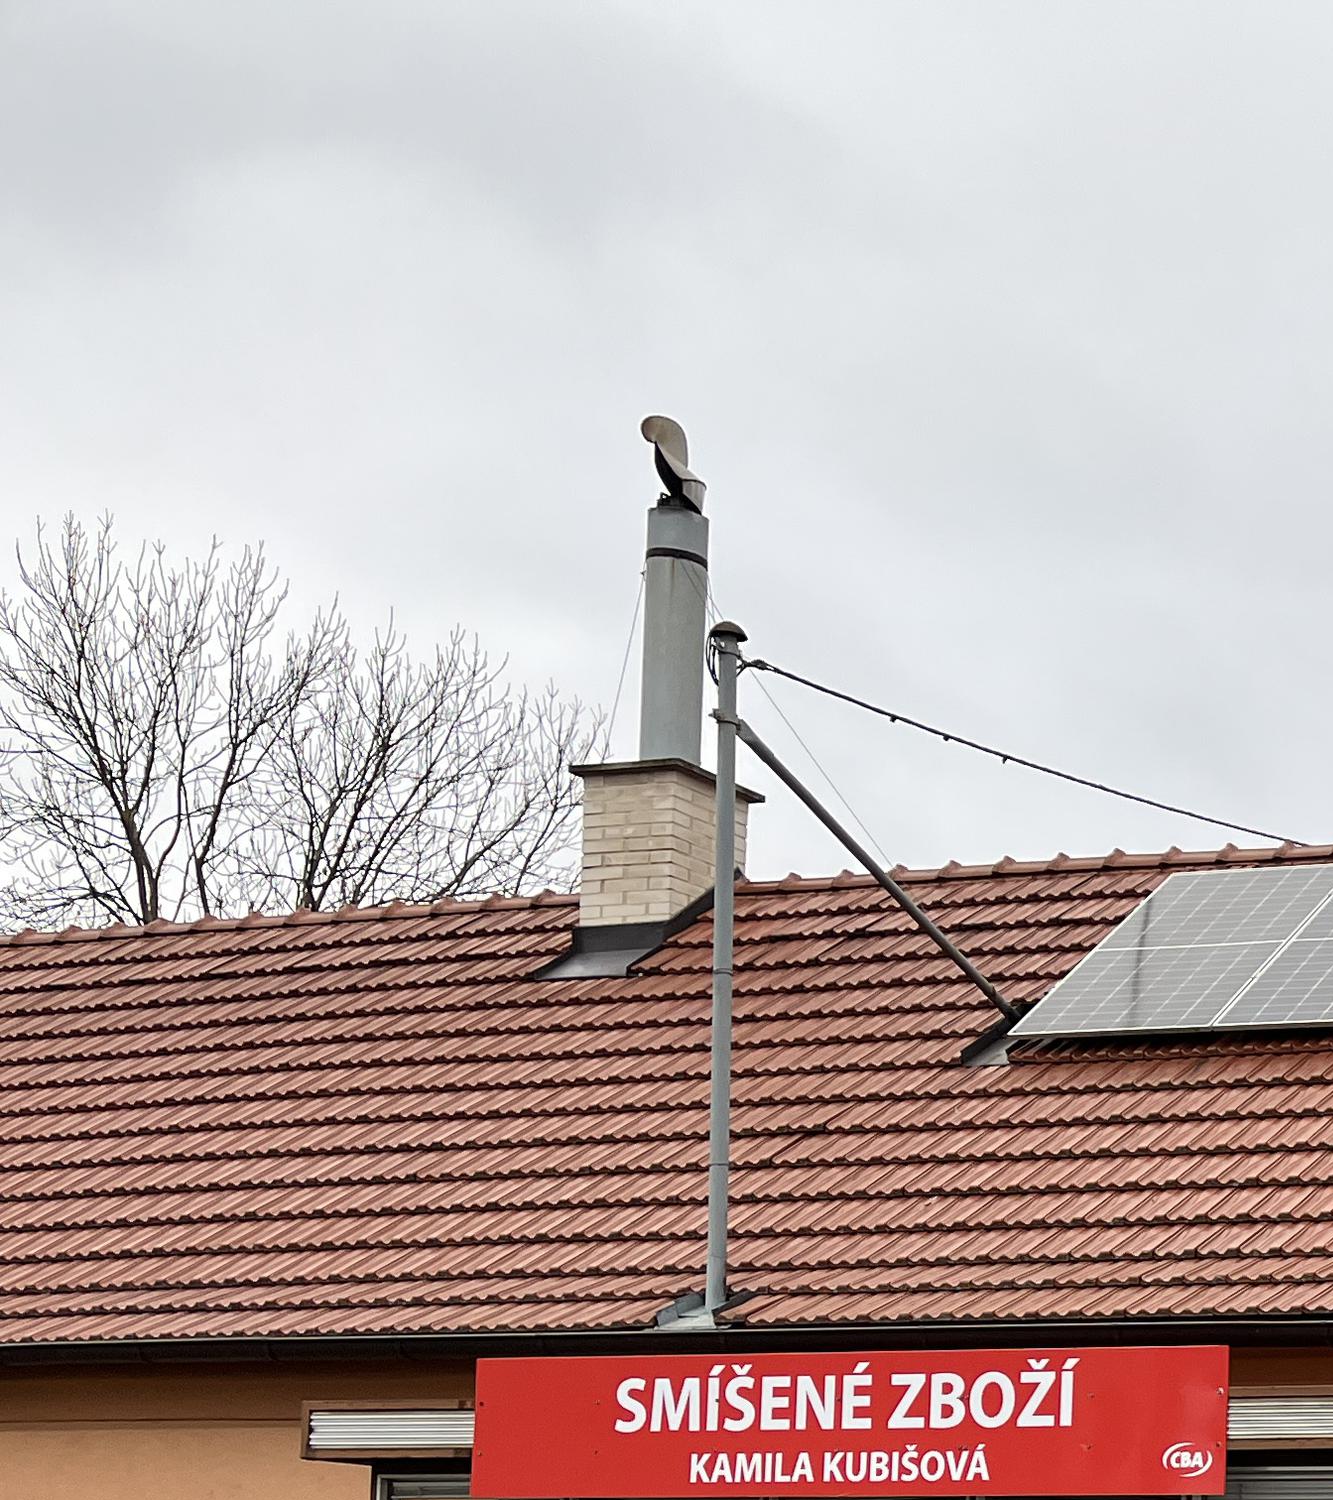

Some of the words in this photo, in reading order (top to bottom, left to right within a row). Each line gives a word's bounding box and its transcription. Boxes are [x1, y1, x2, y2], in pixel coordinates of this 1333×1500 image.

[614, 1361, 873, 1433] SMÍŠENÉ
[887, 1358, 1080, 1430] ZBOŽÍ
[689, 1451, 814, 1483] KAMILA
[823, 1443, 990, 1482] KUBIŠOVÁ
[1169, 1451, 1204, 1469] CBA
